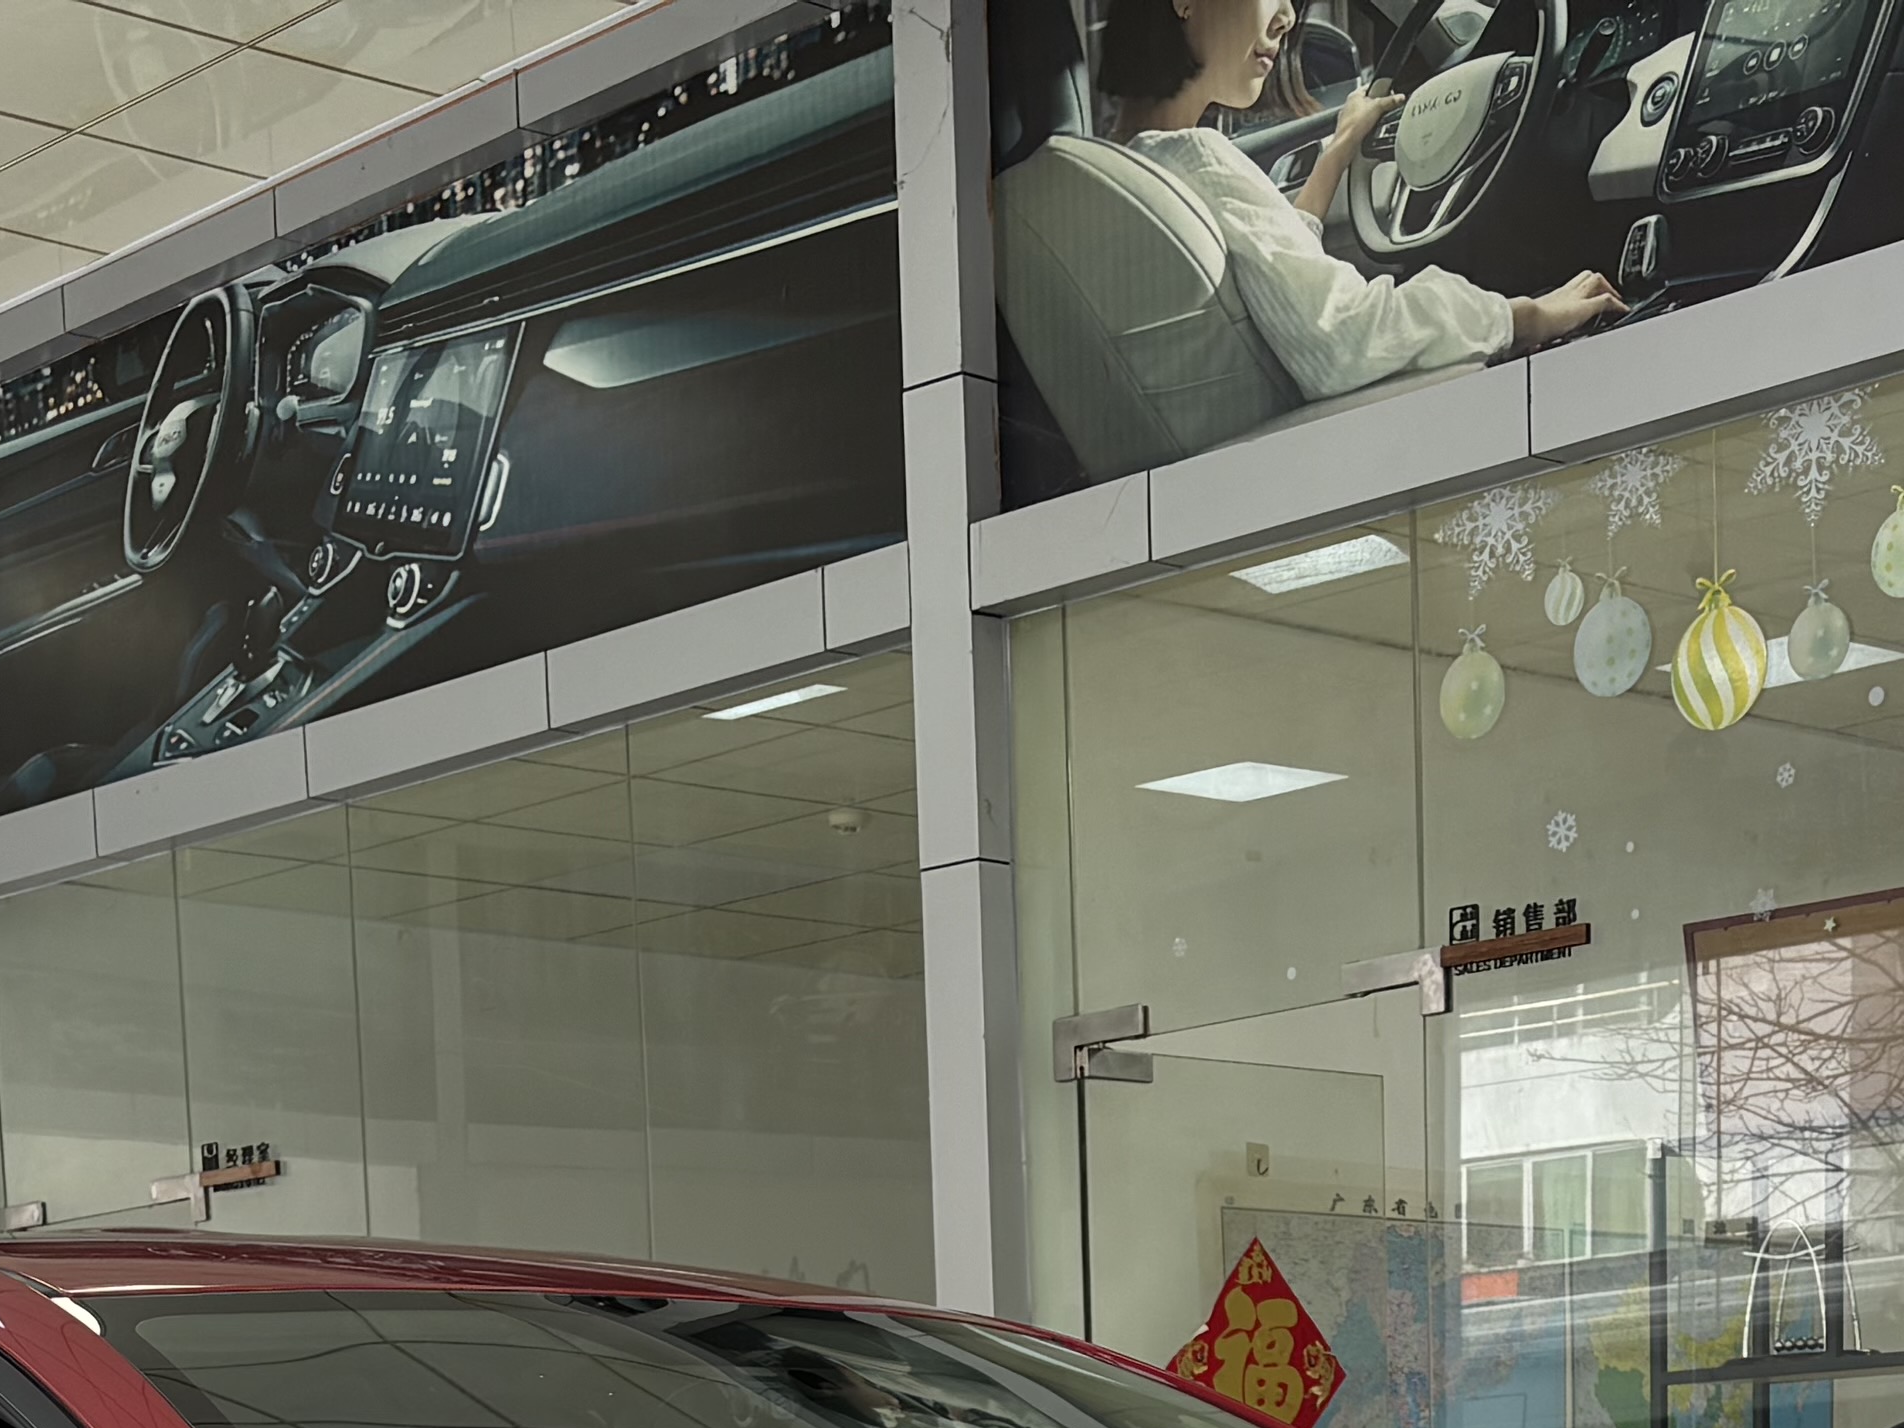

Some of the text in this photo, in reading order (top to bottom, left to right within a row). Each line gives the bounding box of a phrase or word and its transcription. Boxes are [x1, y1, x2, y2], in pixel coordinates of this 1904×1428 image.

[1492, 897, 1578, 939] 销售部
[1212, 1285, 1305, 1426] 福
